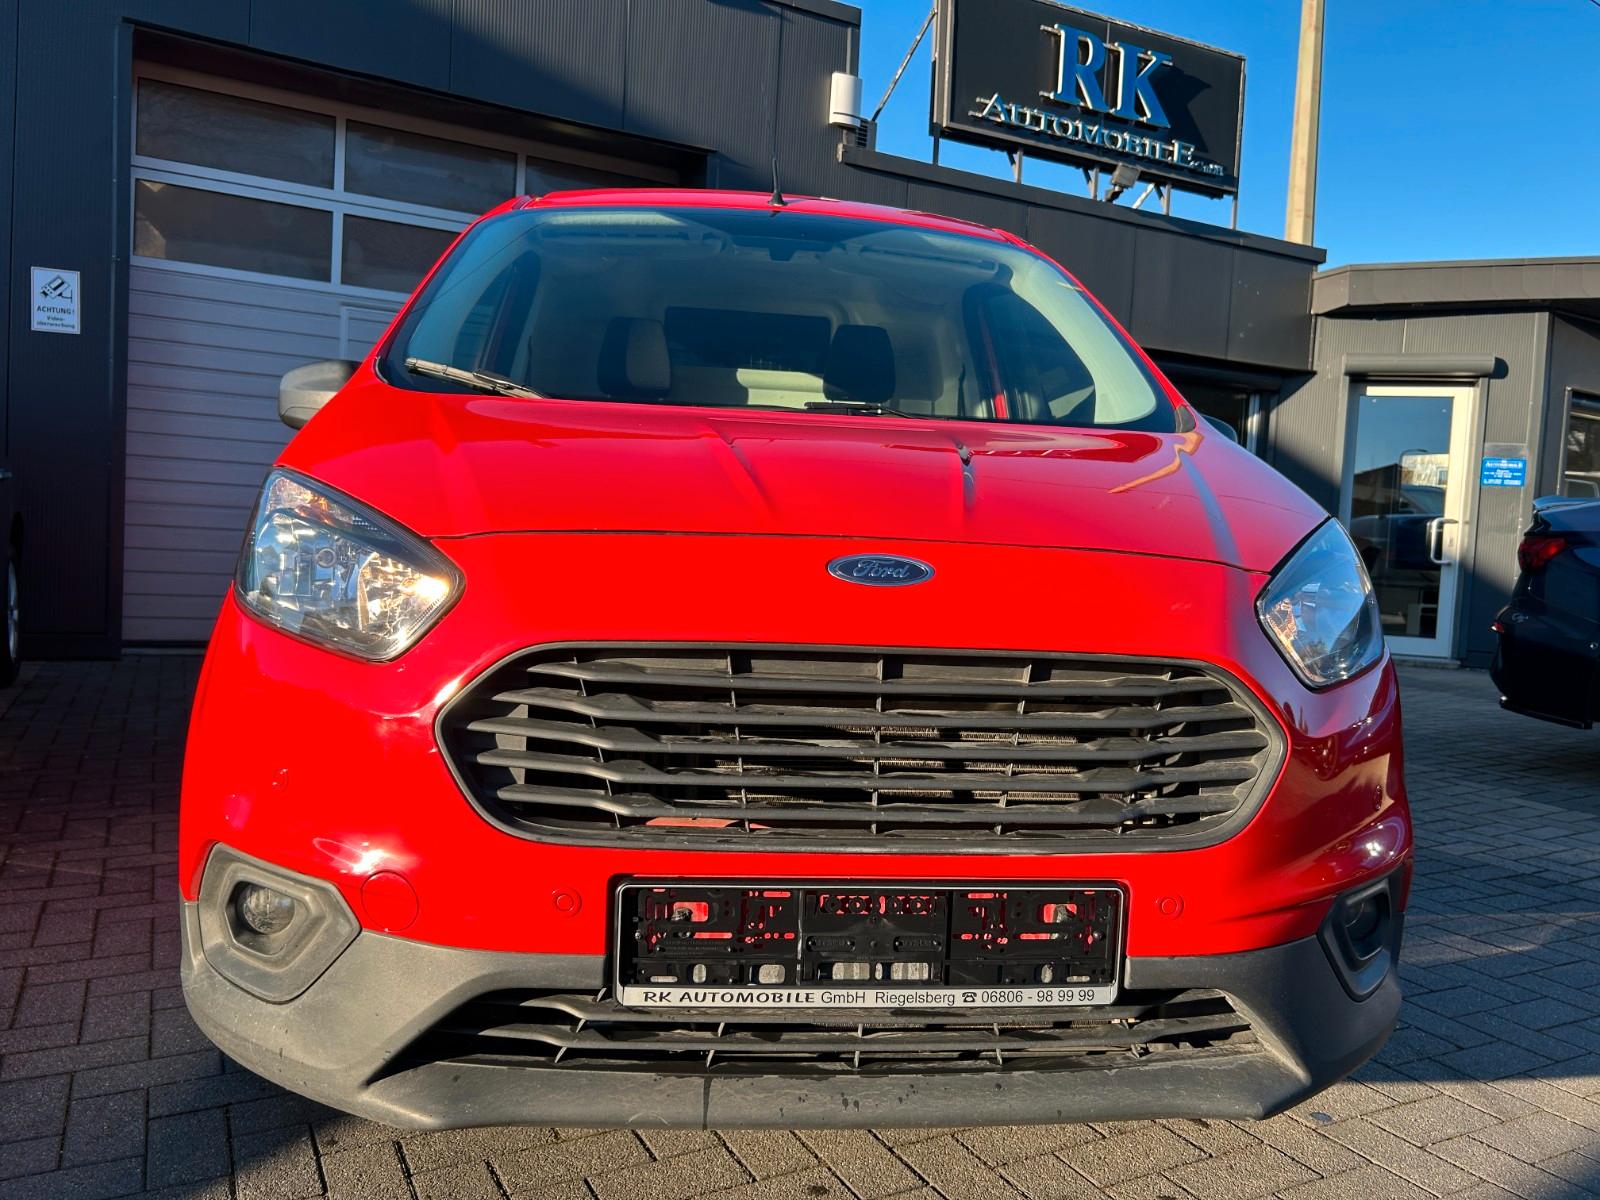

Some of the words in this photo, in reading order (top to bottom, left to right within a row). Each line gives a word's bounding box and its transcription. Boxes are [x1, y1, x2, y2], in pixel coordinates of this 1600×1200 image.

[1041, 22, 1172, 129] RK
[852, 559, 910, 578] Ford
[643, 991, 672, 1003] RK
[679, 991, 815, 1003] AUTOMOBILE
[821, 990, 866, 1004] GmbH
[875, 991, 955, 1006] Riegelsberg
[981, 991, 1023, 1003] 06806
[1037, 991, 1053, 1002] 98
[1057, 990, 1074, 1002] 99
[1078, 989, 1095, 1002] 99
